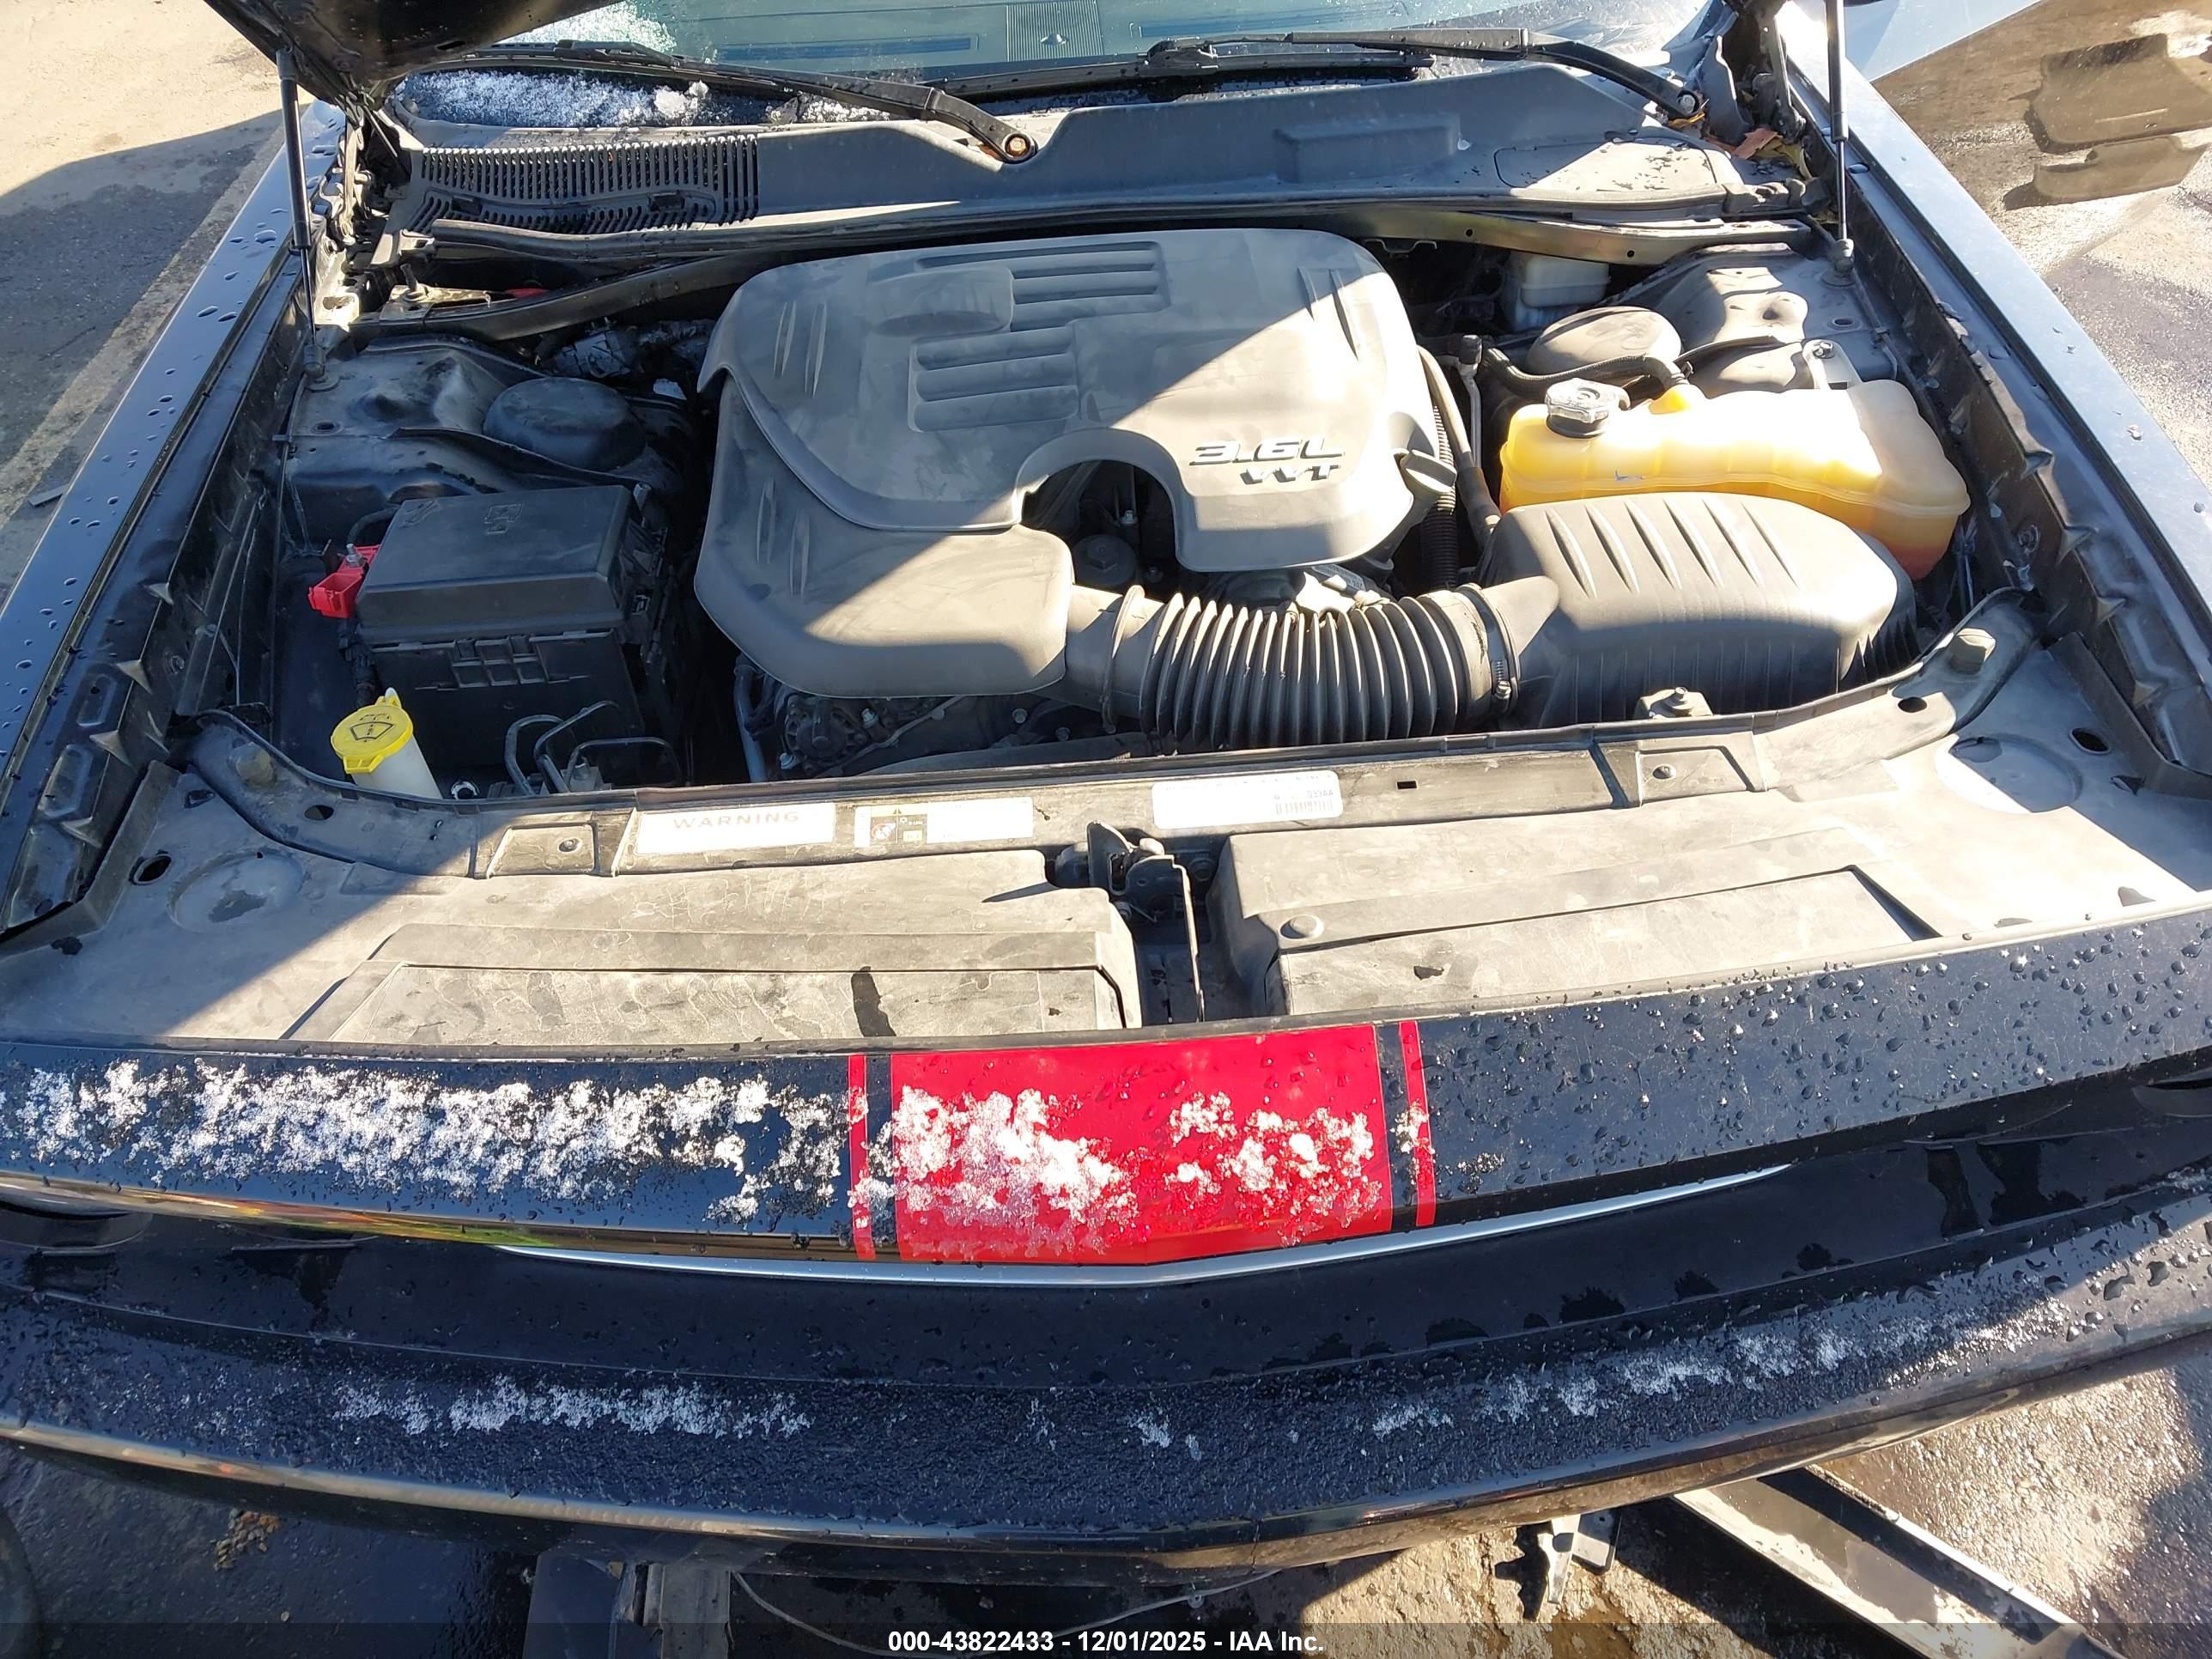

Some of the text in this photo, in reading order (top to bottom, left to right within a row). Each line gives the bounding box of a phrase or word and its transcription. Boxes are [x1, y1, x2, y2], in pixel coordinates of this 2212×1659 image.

[1189, 436, 1345, 465] 3.6L
[1239, 464, 1341, 485] VVT
[673, 810, 800, 830] WARNING
